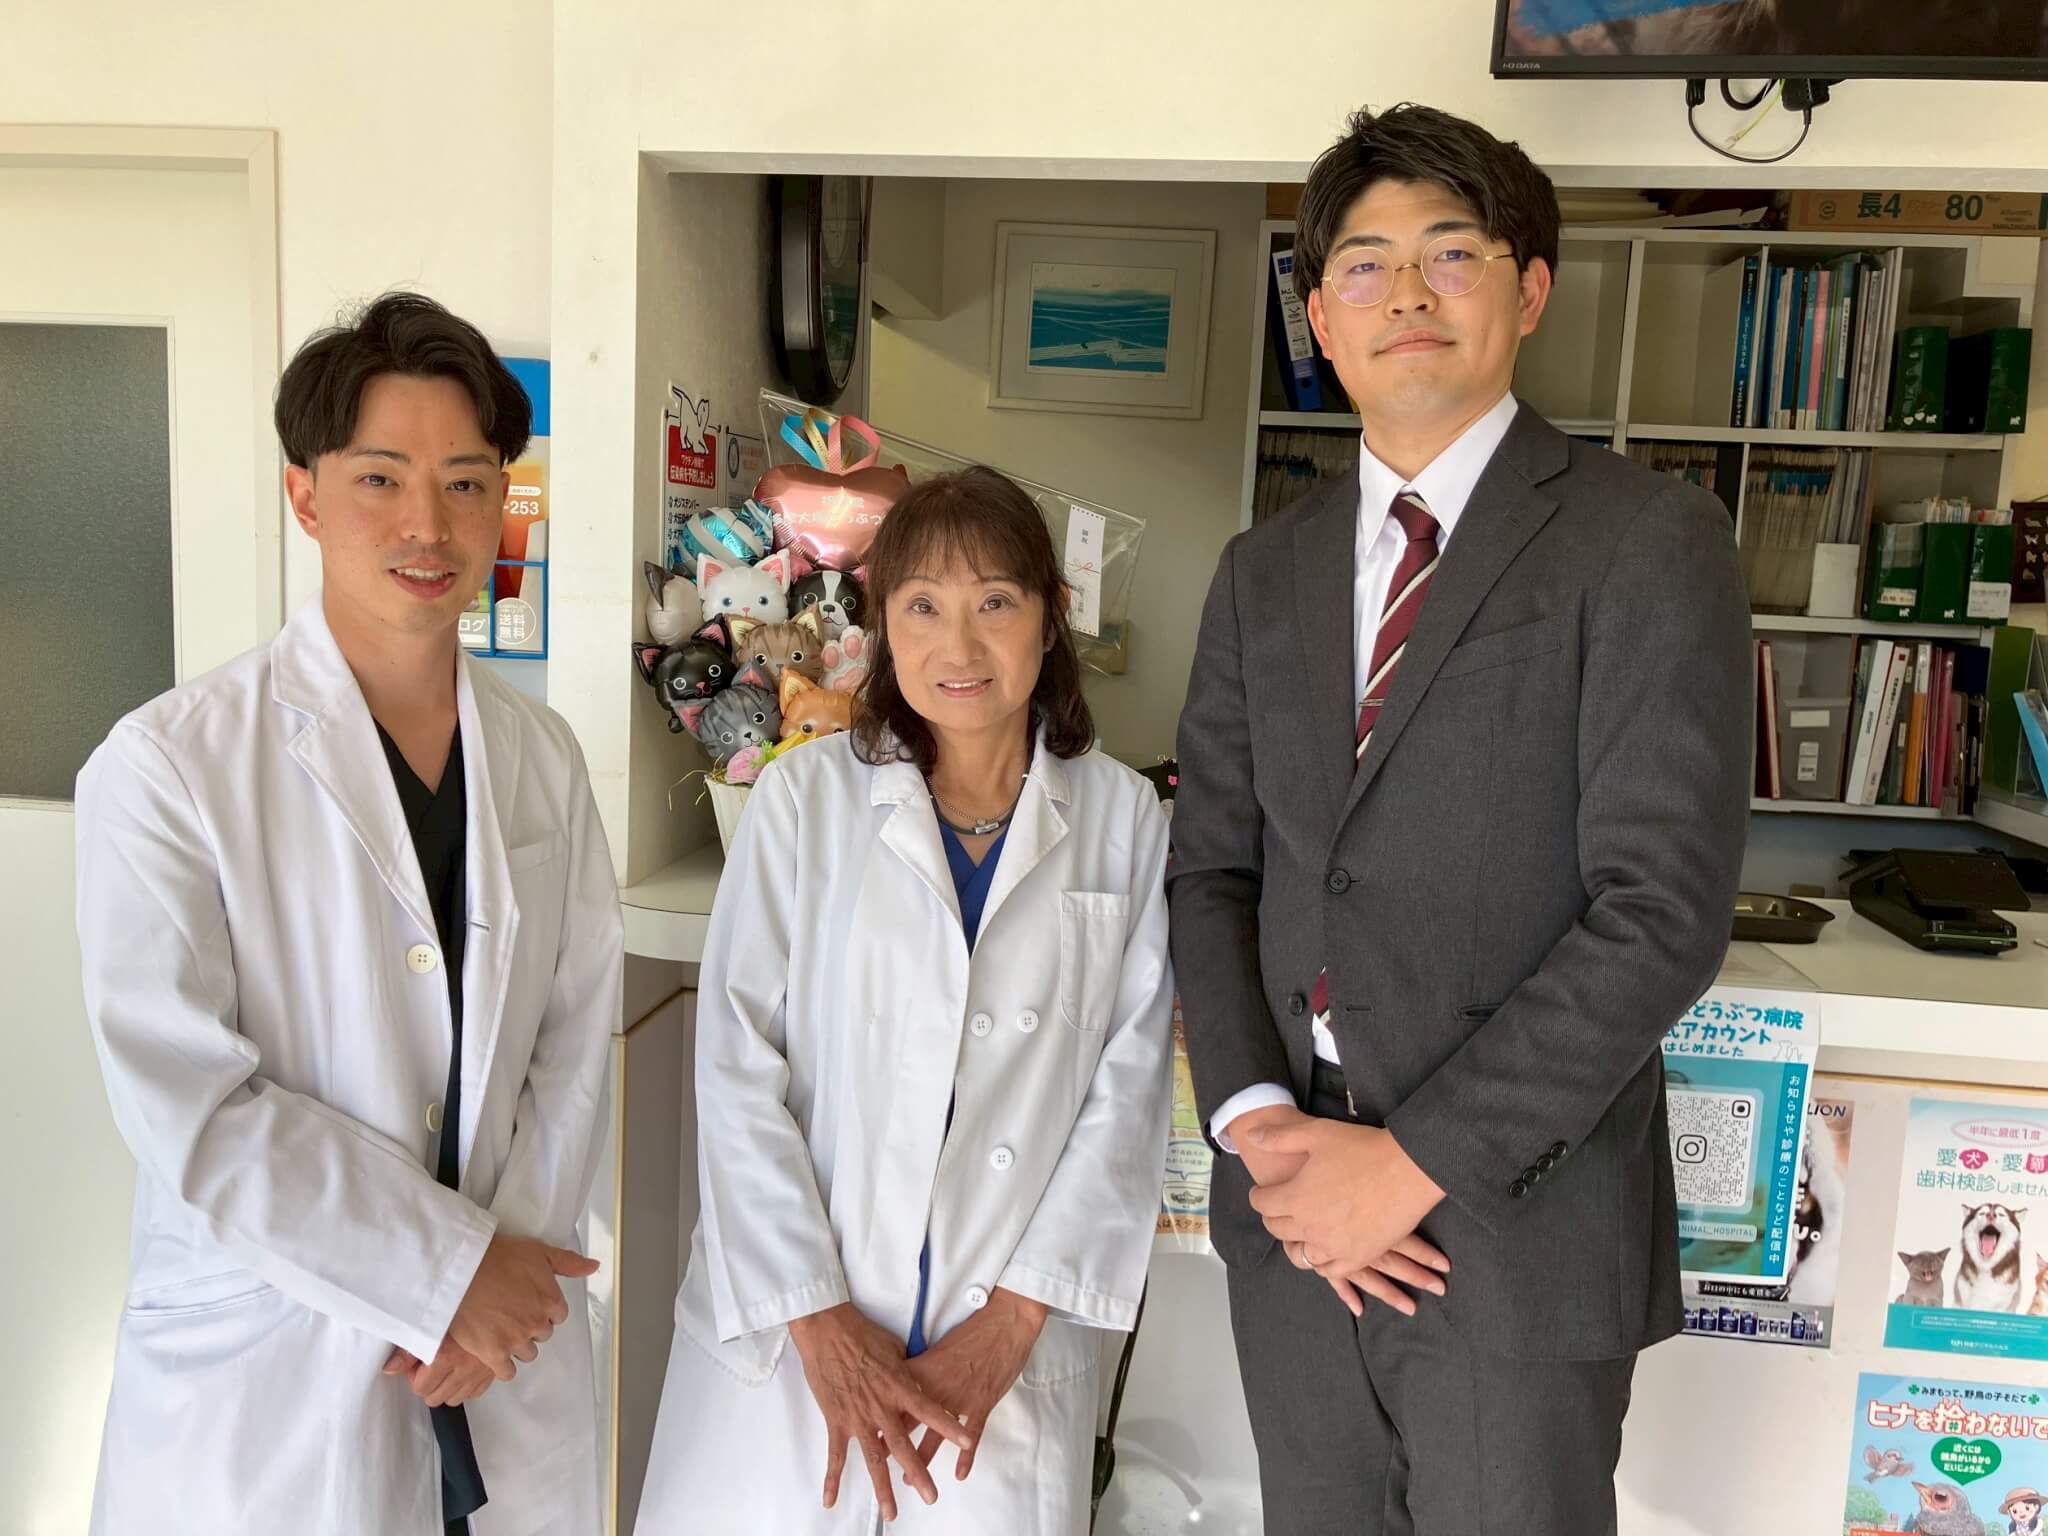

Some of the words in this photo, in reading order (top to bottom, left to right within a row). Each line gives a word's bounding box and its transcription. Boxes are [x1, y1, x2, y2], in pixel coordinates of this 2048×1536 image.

[1857, 192, 1902, 218] 長4
[1944, 194, 1984, 220] 80
[1688, 1001, 1804, 1030] どうぶつ病院
[1664, 1042, 1744, 1057] はじめました
[1807, 1103, 1847, 1118] LION
[1769, 1075, 1800, 1264] お知らせや診療のことなど配信中
[1921, 1388, 2027, 1403] みまもって、野鳥の子そだて
